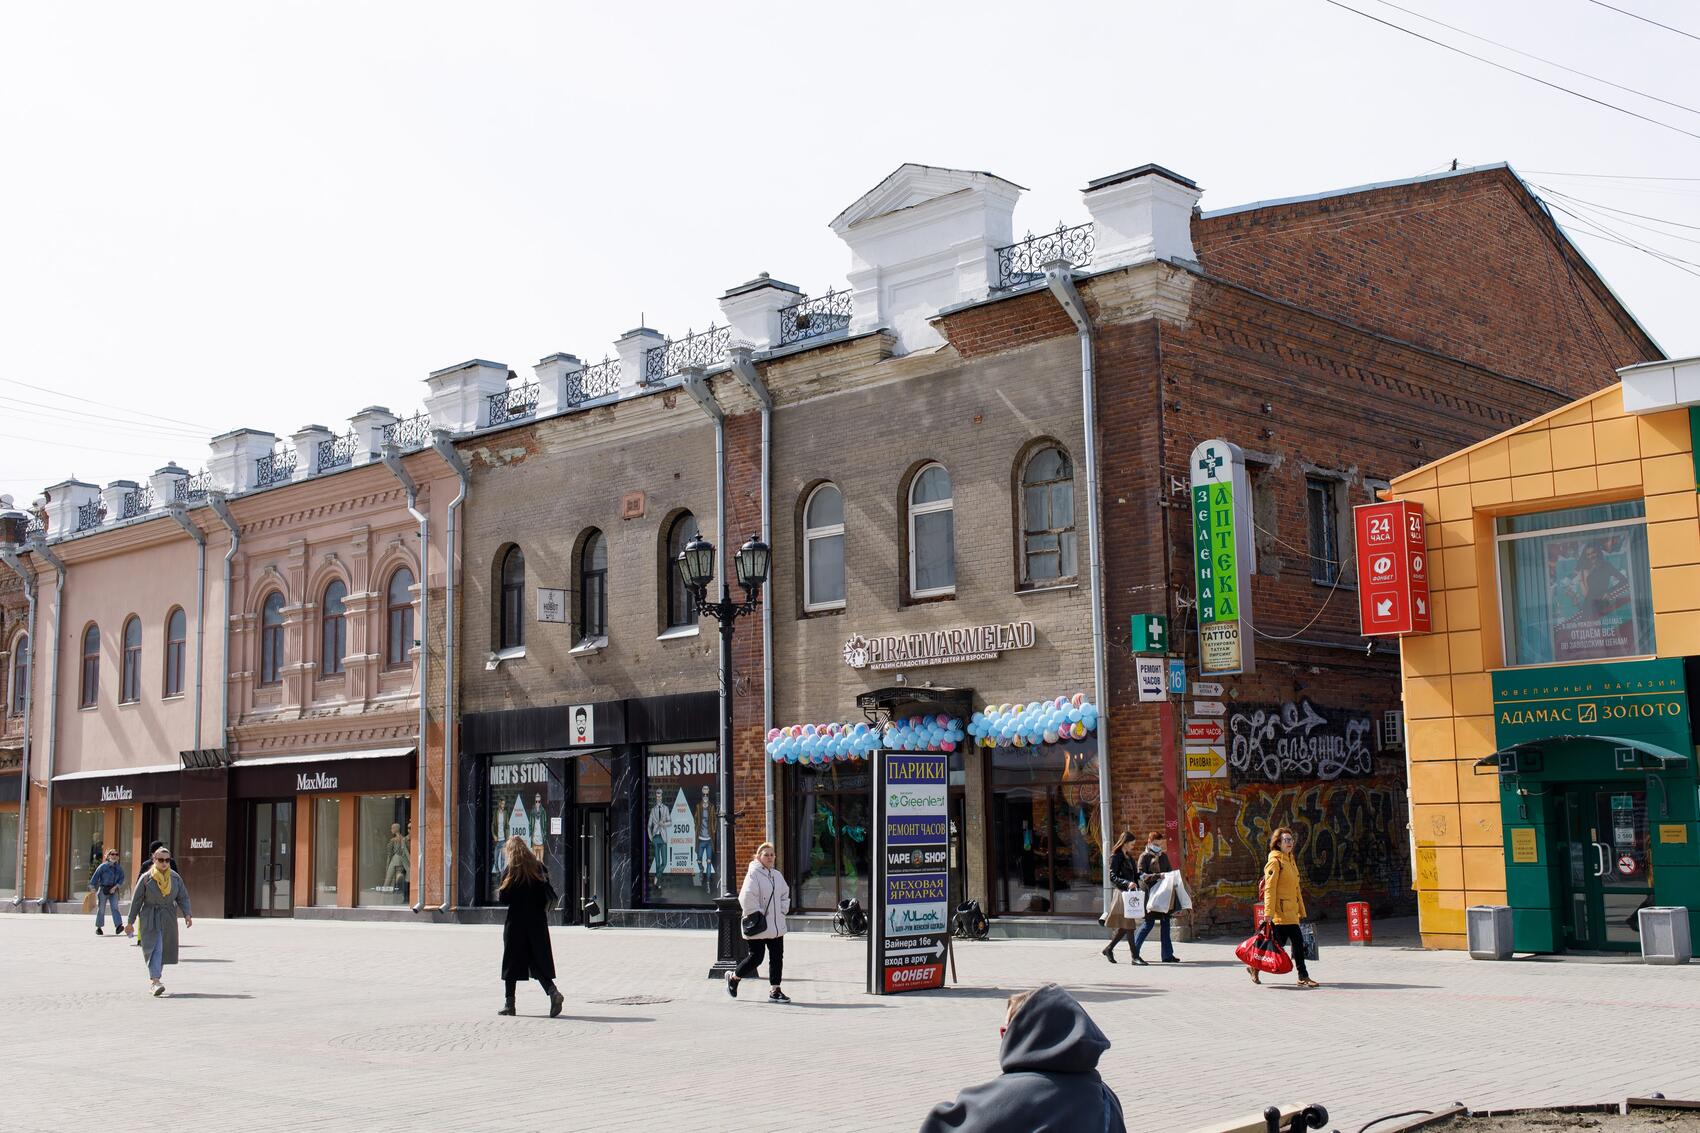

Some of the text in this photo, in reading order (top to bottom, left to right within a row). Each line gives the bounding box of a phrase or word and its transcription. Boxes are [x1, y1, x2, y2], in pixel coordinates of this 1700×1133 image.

[1370, 518, 1390, 534] 24
[1410, 516, 1420, 532] 24
[1371, 533, 1390, 541] ЧАСА
[1215, 487, 1234, 615] АПТЕКА
[1201, 630, 1238, 640] TATTOO
[868, 621, 1034, 662] PIRATMARMELAD
[896, 660, 928, 668] СЛАДОСТЕЙ
[1140, 665, 1162, 673] РЕМОНТ
[1143, 676, 1160, 685] ЧАСОВ
[1502, 680, 1676, 696] ЮВЕЛИРНЫЙ МАГАЗИН
[1501, 702, 1681, 724] АДАМАС ЗОЛОТО
[647, 755, 681, 776] MEN'S
[889, 762, 944, 779] ПАРИКИ
[490, 764, 518, 784] MEN'S
[296, 772, 338, 790] MaxMara
[101, 786, 132, 801] MaxMara
[900, 796, 944, 808] Greenleaf
[512, 827, 526, 836] 1800
[674, 824, 690, 834] 2500
[888, 823, 946, 836] РЕМОНТ ЧАСОВ
[191, 838, 213, 849] MaxMara
[888, 852, 946, 864] VAPE SHOP
[890, 879, 944, 890] МЕХОВАЯ
[891, 890, 944, 900] ЯРМАРКА
[884, 936, 932, 948] Вайнера 16е
[911, 956, 928, 964] арку
[892, 968, 936, 982] ФОНБЕТ
